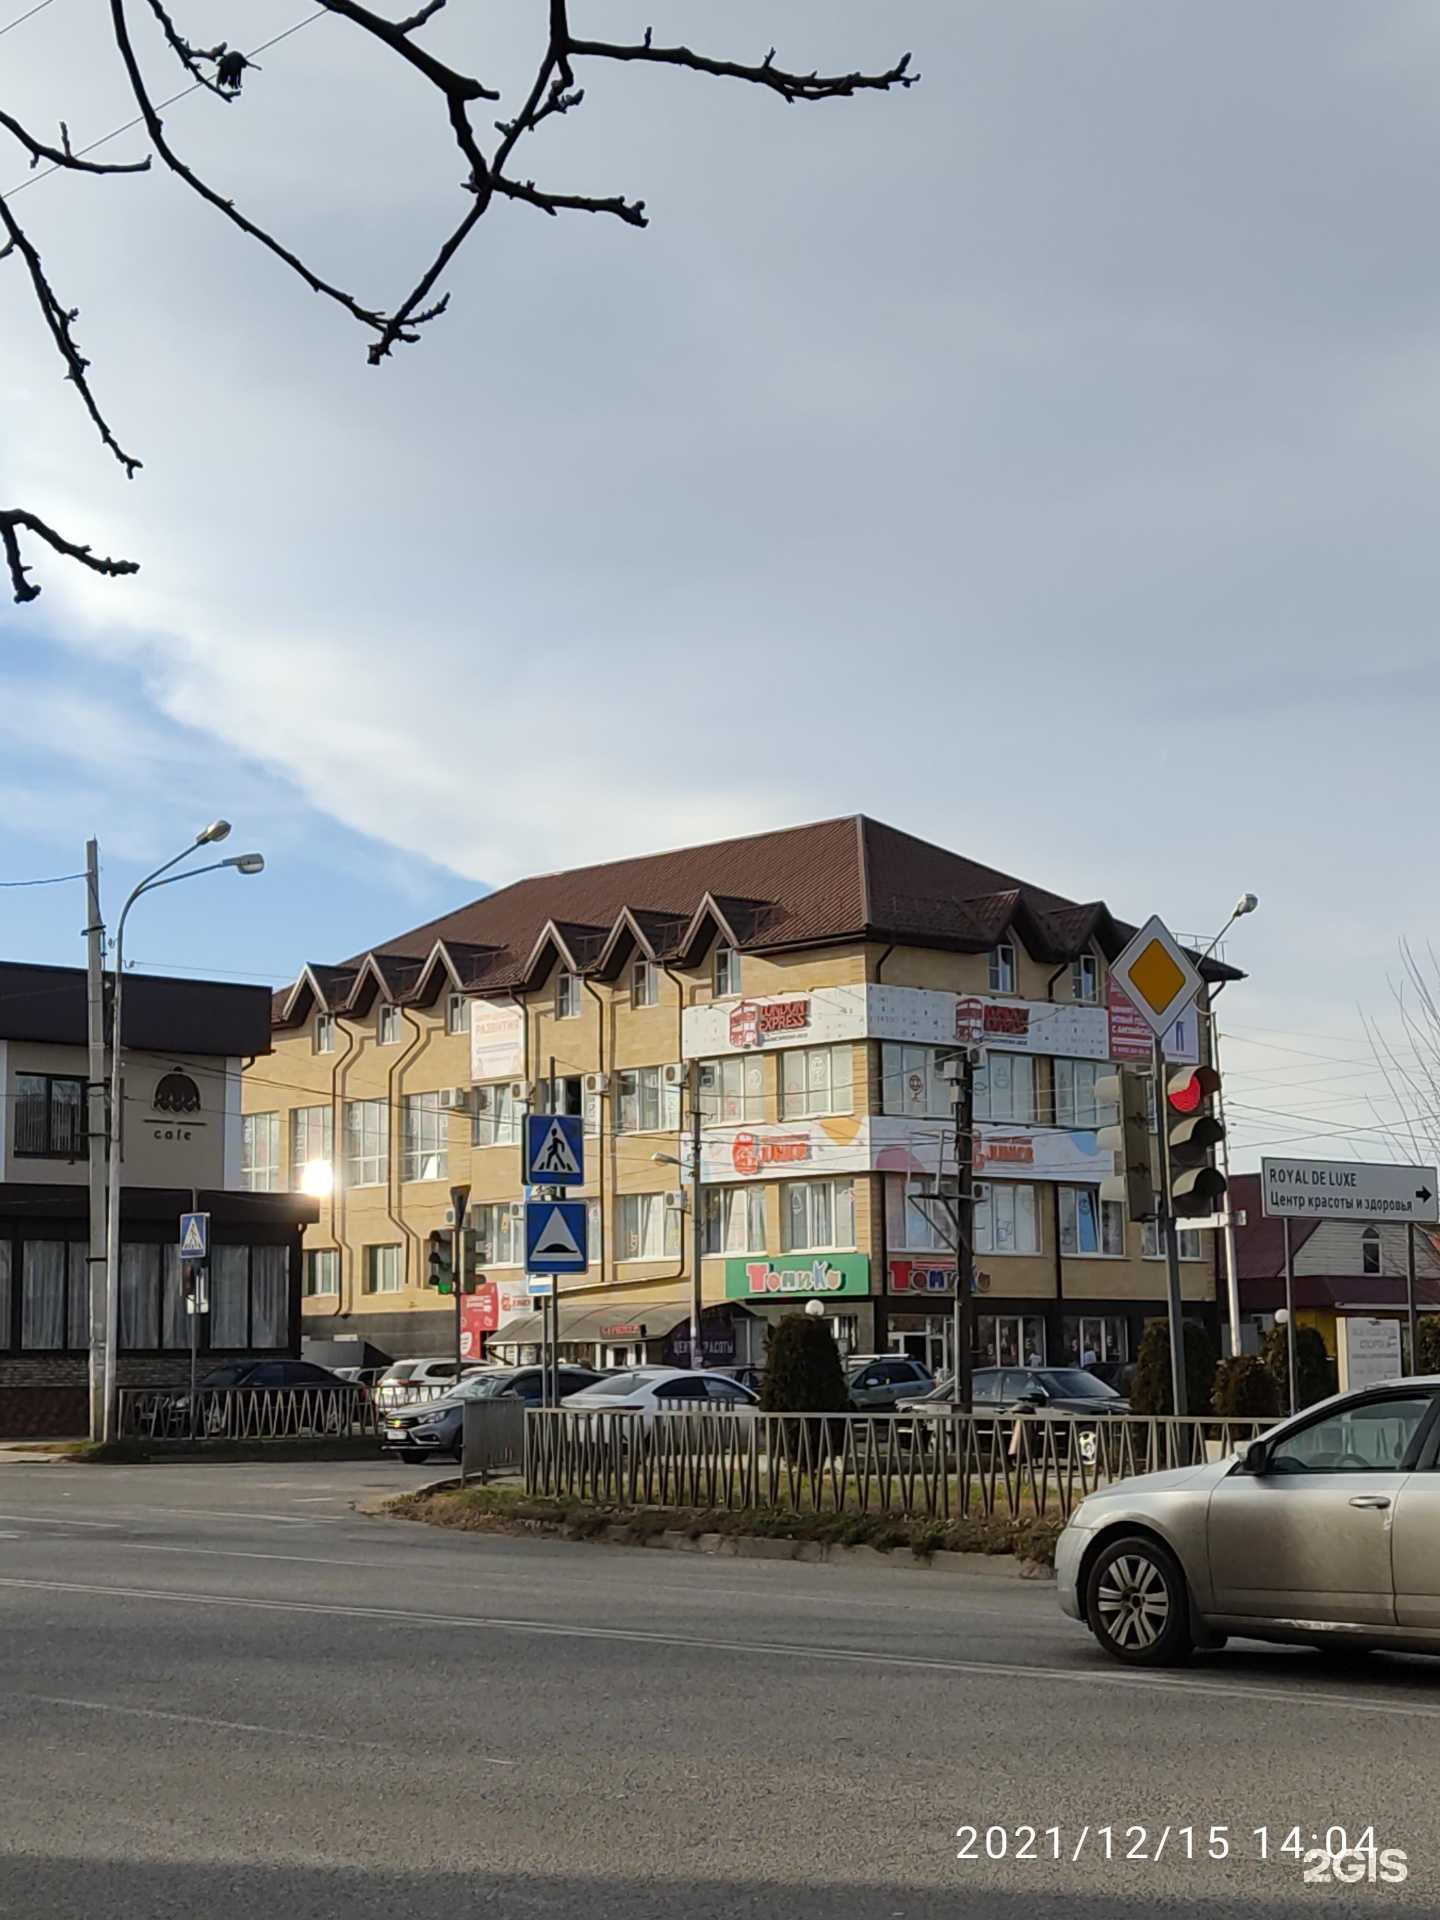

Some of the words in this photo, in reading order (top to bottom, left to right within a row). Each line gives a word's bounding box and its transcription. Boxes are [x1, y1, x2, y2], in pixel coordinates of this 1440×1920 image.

[760, 1000, 806, 1017] LONDON
[759, 1014, 806, 1032] EXPRESS
[153, 1128, 192, 1141] cafe
[1269, 1168, 1308, 1185] ROYAL
[1311, 1170, 1329, 1185] DE
[1329, 1171, 1357, 1187] LUXE
[1270, 1191, 1305, 1211] Центр
[1308, 1195, 1353, 1212] красоты
[1356, 1199, 1363, 1208] и
[1365, 1200, 1413, 1213] здоровья
